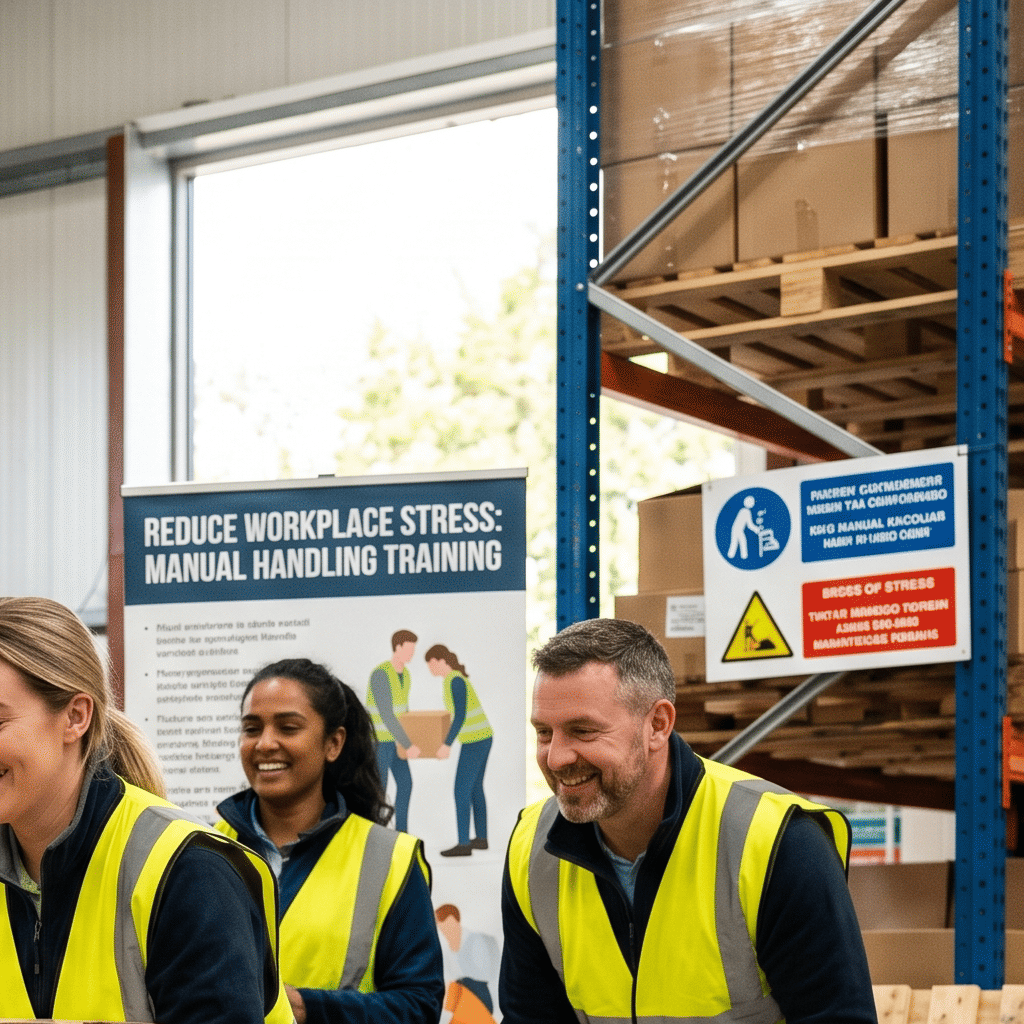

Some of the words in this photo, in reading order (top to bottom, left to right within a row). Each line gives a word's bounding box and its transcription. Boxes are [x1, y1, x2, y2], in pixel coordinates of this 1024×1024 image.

[144, 513, 238, 547] REDUCE
[244, 506, 394, 543] WORKPLACE
[399, 501, 503, 536] STRESS:
[144, 551, 247, 584] MANUAL
[252, 544, 377, 580] HANDLING
[383, 539, 502, 575] TRAINING
[884, 576, 936, 593] STRESS
